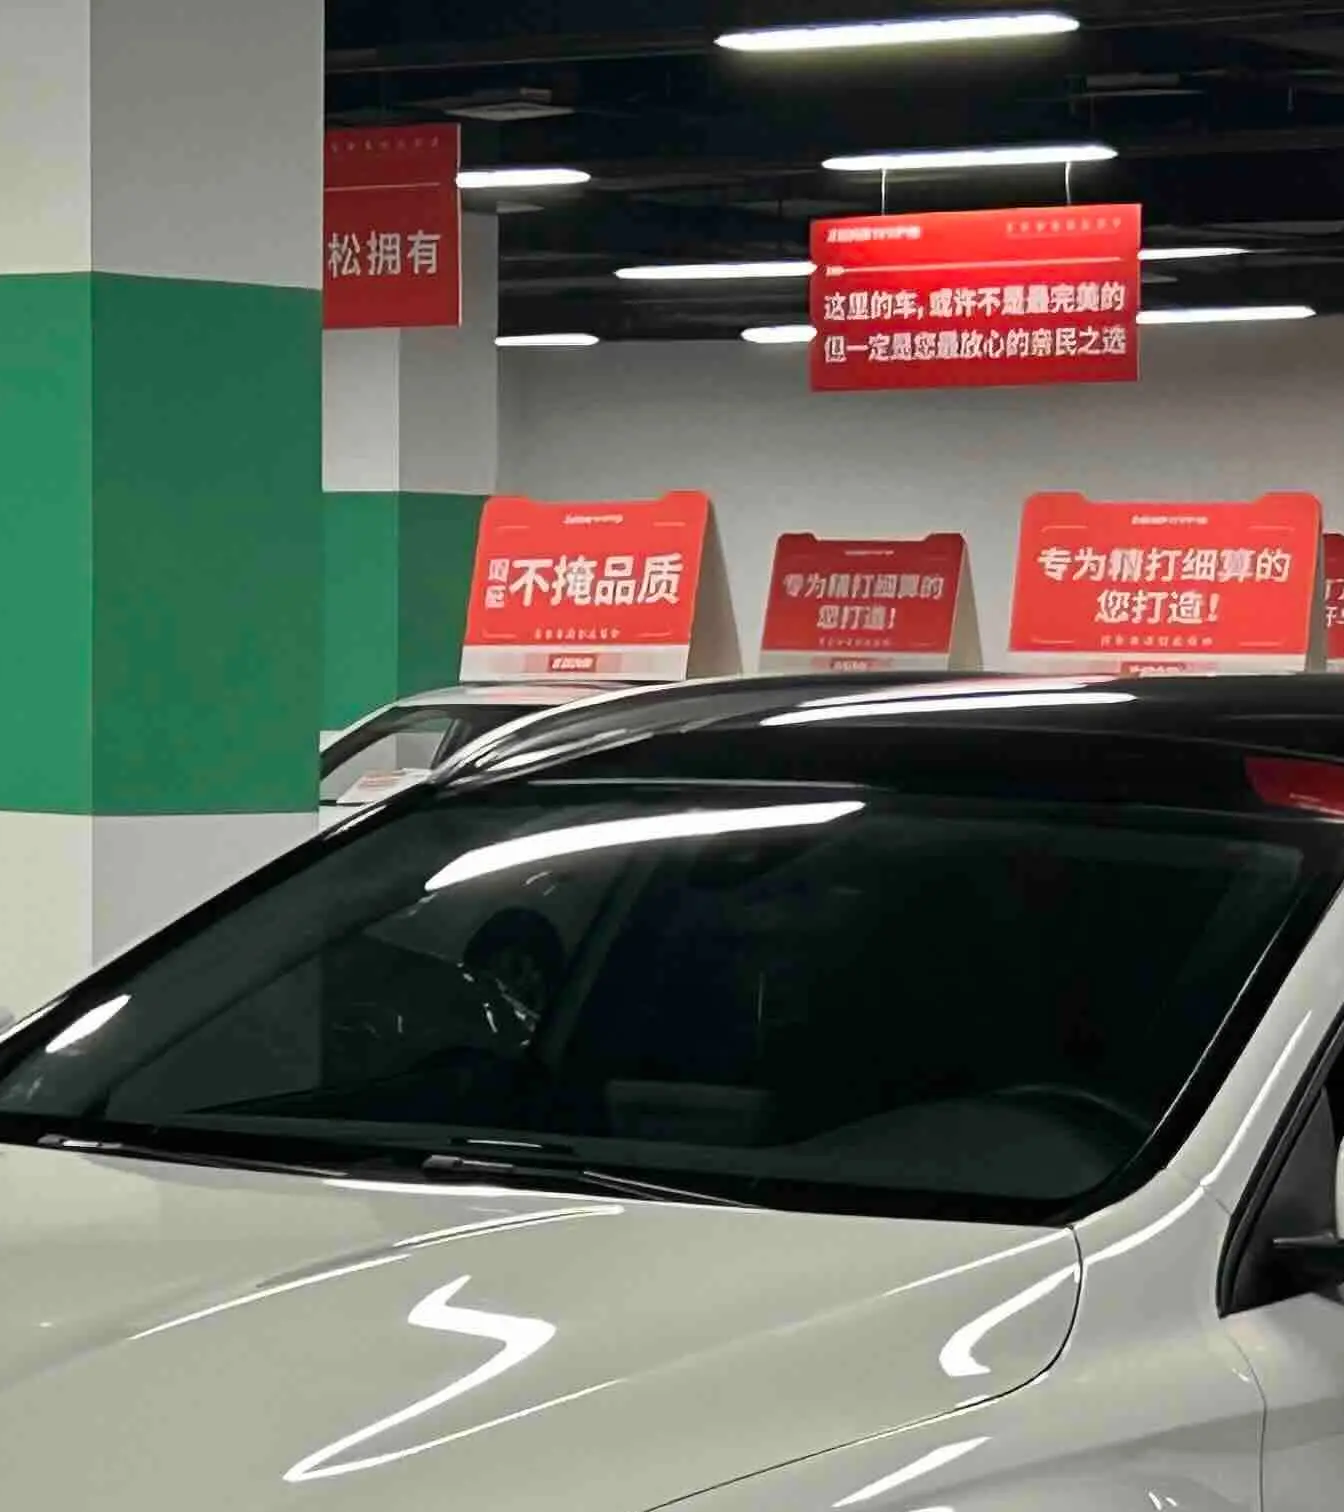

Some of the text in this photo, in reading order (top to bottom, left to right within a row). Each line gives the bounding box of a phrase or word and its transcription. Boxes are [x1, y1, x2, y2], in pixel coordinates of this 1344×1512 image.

[328, 229, 441, 279] 松拥有
[508, 552, 684, 607] 不掩品质
[1037, 547, 1292, 583] 专为精打细算的
[1095, 590, 1220, 624] 您打造!
